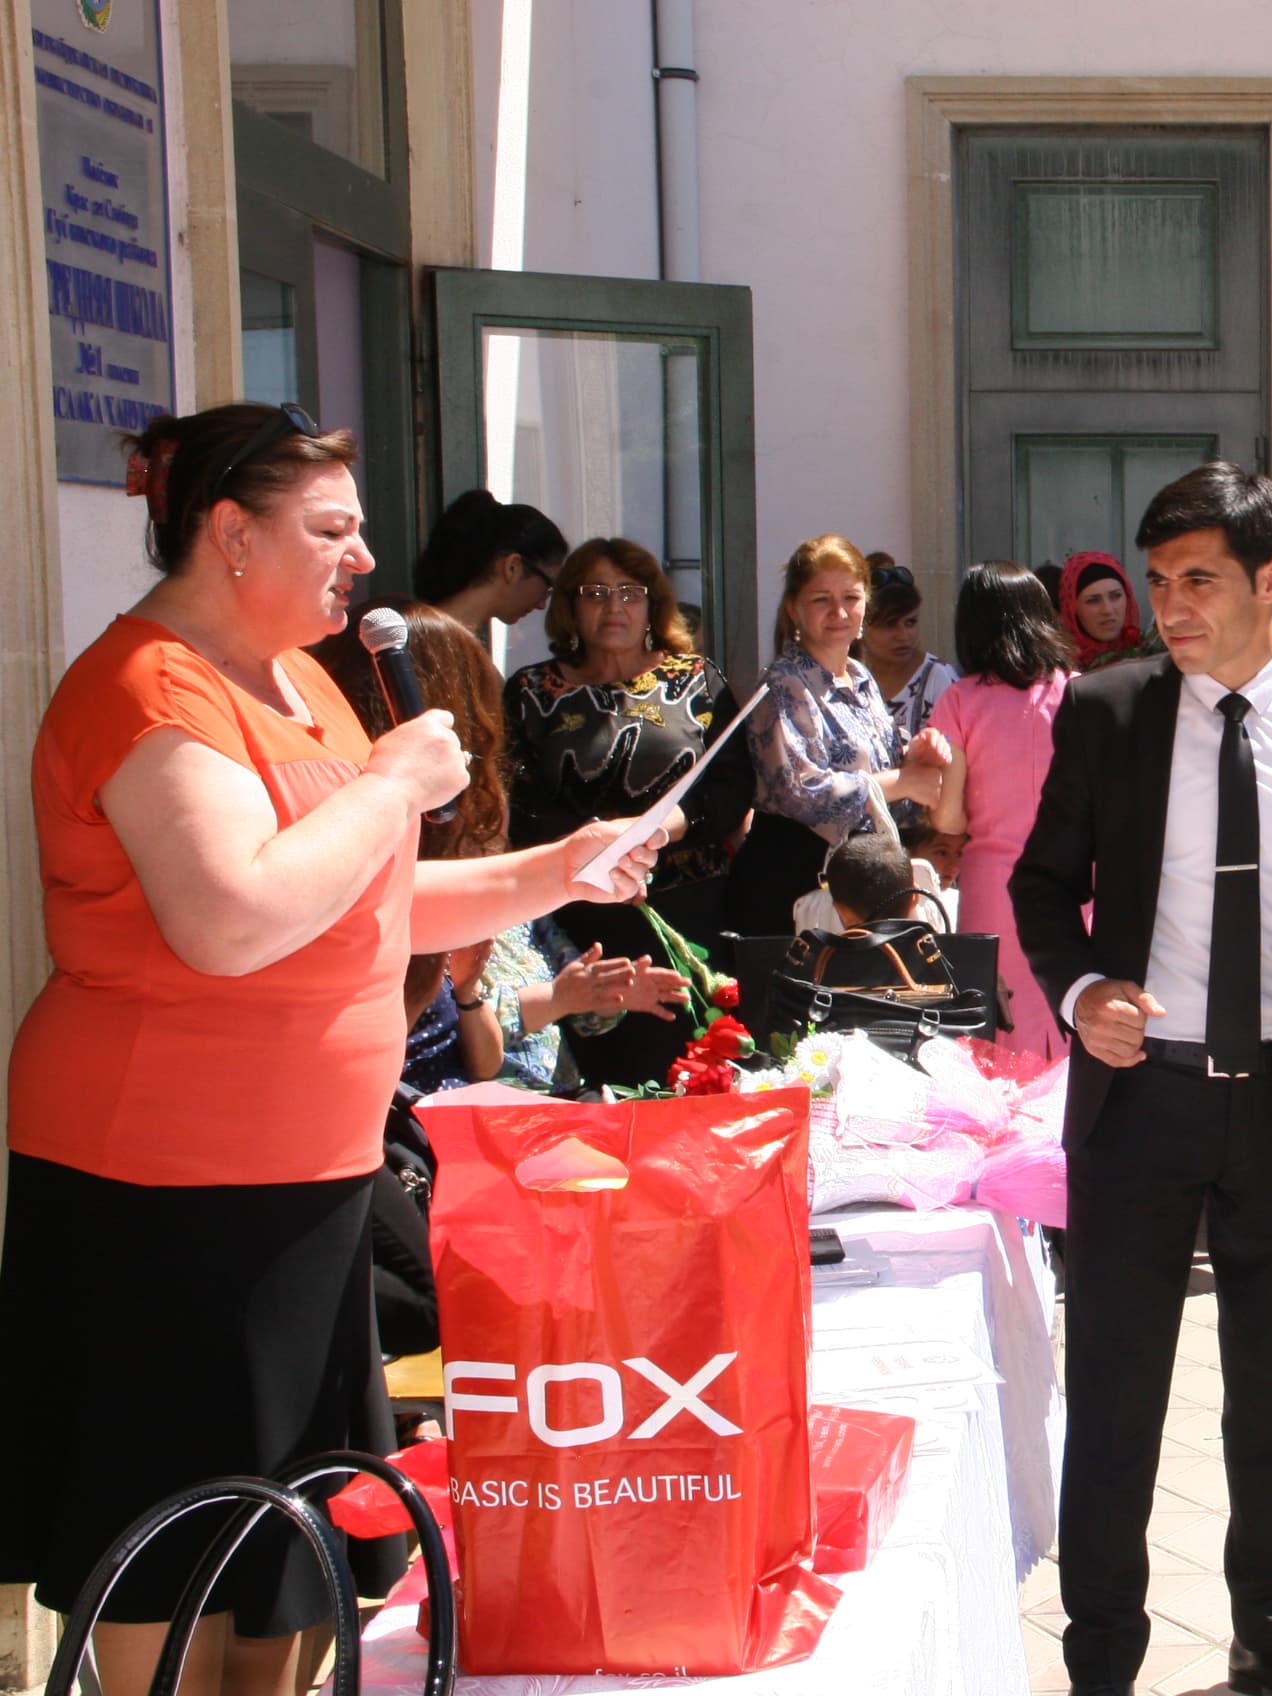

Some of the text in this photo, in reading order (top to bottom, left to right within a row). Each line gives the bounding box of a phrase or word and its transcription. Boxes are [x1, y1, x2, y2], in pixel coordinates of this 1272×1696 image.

[443, 1351, 744, 1448] FOX
[450, 1474, 742, 1510] BASIC IS BEAUTIFUL
